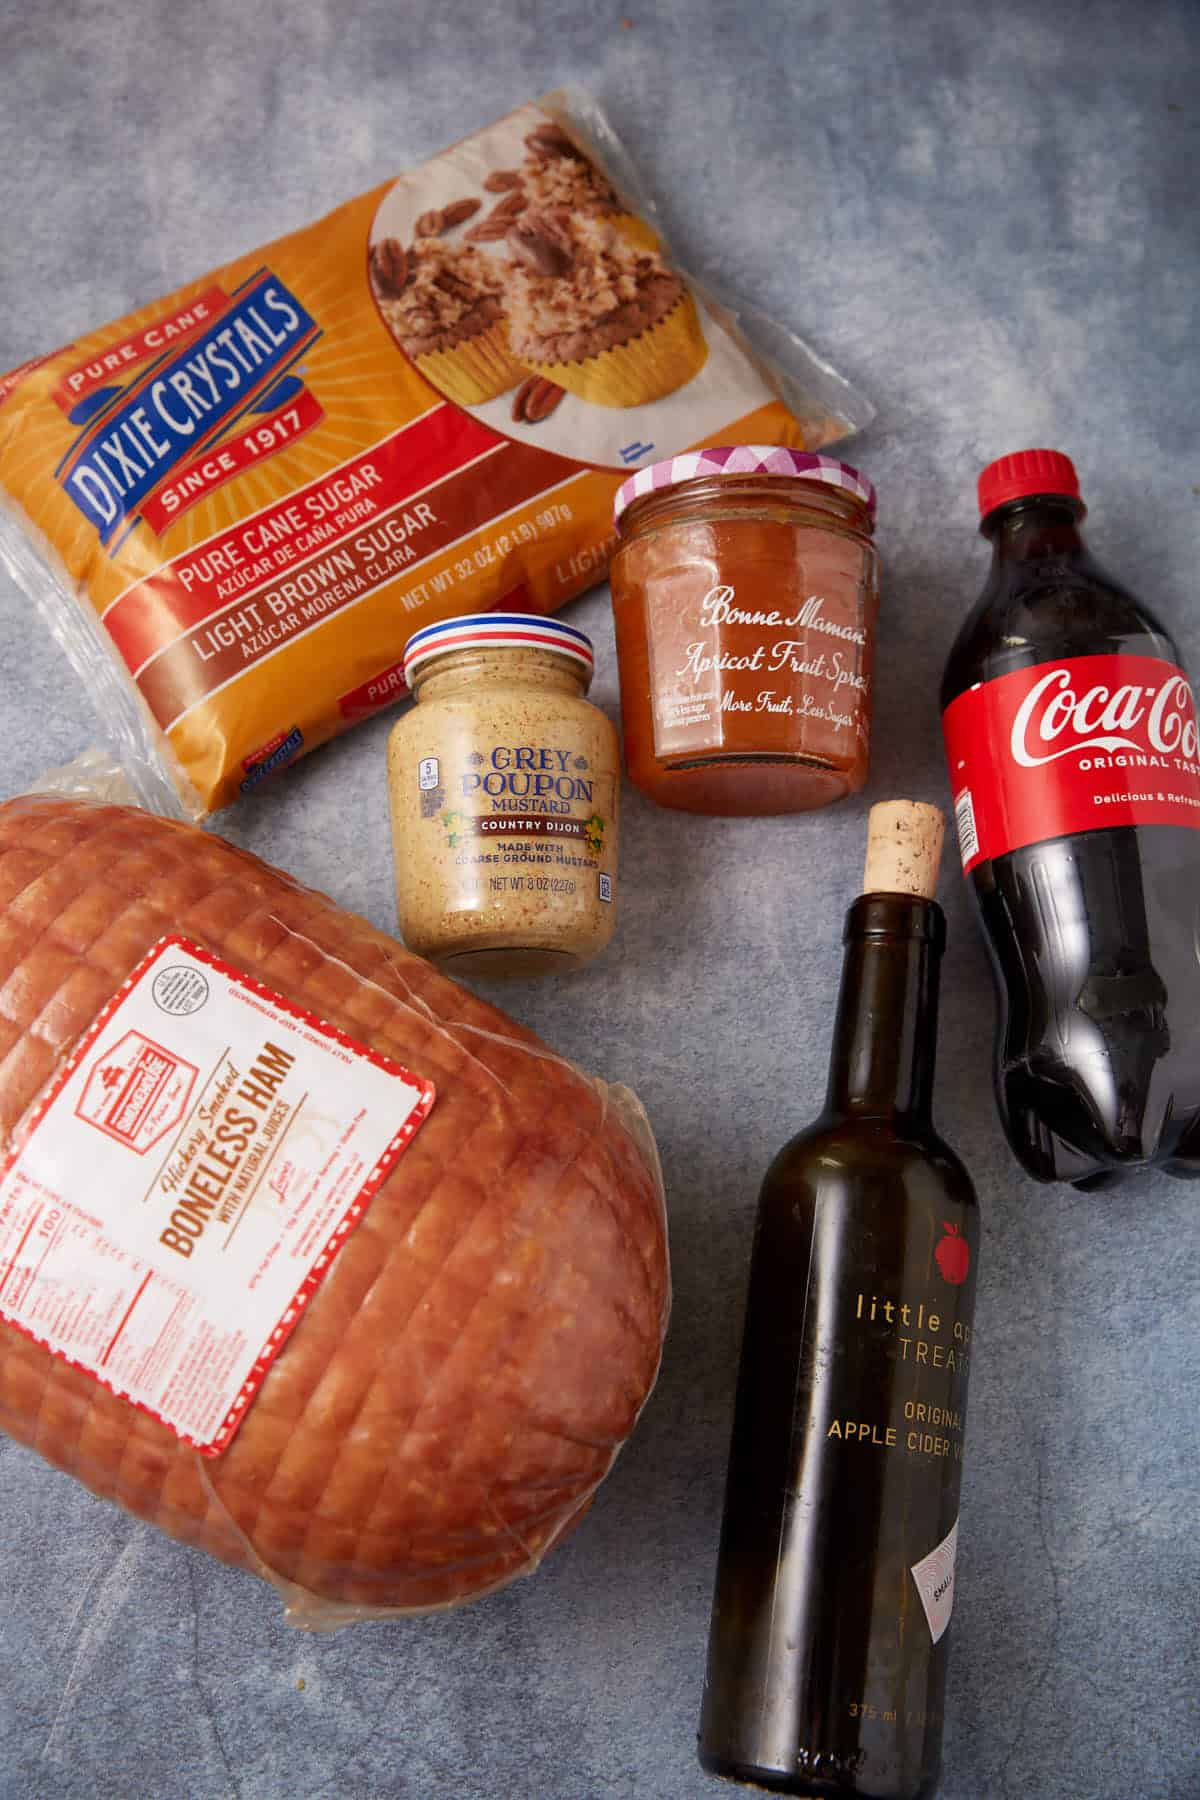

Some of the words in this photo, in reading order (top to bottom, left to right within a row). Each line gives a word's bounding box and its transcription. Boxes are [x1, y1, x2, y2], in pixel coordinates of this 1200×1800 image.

[68, 347, 137, 392] PURE
[143, 303, 209, 347] CANE
[72, 405, 170, 526] DIXIE
[152, 288, 299, 435] CRYSTALS
[161, 452, 236, 512] SINCE
[244, 410, 301, 455] 1917
[178, 540, 245, 592] PURE
[242, 508, 308, 555] CANE
[305, 464, 383, 519] SUGAR
[215, 555, 275, 599] AZÚCAR
[275, 543, 297, 565] DE
[295, 519, 337, 556] CAÑA
[336, 498, 378, 529] PURA
[192, 604, 266, 662] LIGHT
[264, 549, 356, 616] BROWN
[355, 502, 437, 561] SUGAR
[400, 583, 431, 612] NET
[429, 568, 455, 594] WT
[454, 558, 476, 580] 32
[473, 545, 497, 568] OZ
[240, 614, 301, 659] AZÚCAR
[303, 573, 367, 621] MORENA
[365, 545, 417, 581] CLARA
[700, 585, 784, 628] Bonne
[785, 595, 866, 645] Maman
[676, 641, 766, 683] Apricot
[767, 640, 826, 676] Fruit
[719, 690, 753, 713] More
[754, 691, 793, 716] Fruit,
[797, 694, 825, 717] Less
[1011, 669, 1200, 768] Coca-Co
[425, 762, 432, 775] 5
[491, 747, 572, 772] GREY
[1078, 755, 1169, 771] ORIGINAL
[462, 772, 594, 802] POUPON
[1094, 792, 1154, 805] Delicious
[1157, 792, 1165, 801] &
[492, 799, 571, 814] MUSTARD
[481, 820, 541, 830] COUNTRY
[546, 823, 580, 833] DIJON
[455, 854, 499, 865] COARSE
[503, 854, 552, 864] GROUND
[497, 842, 532, 851] MADE
[535, 842, 563, 853] WITH
[489, 877, 507, 891] NET
[510, 877, 525, 891] WT
[527, 876, 534, 890] 8
[536, 877, 549, 891] OZ
[161, 1128, 207, 1194] Hickory
[198, 1060, 240, 1129] Smoked
[159, 1107, 258, 1258] BONELESS
[237, 1041, 296, 1111] HAM
[216, 1191, 240, 1224] WITH
[234, 1142, 269, 1195] NATURAL
[262, 1100, 290, 1141] JUICES
[38, 1208, 61, 1239] 100
[856, 1294, 941, 1331] little
[827, 1420, 897, 1447] APPLE
[907, 1432, 950, 1457] CIDER
[848, 1703, 877, 1719] 375
